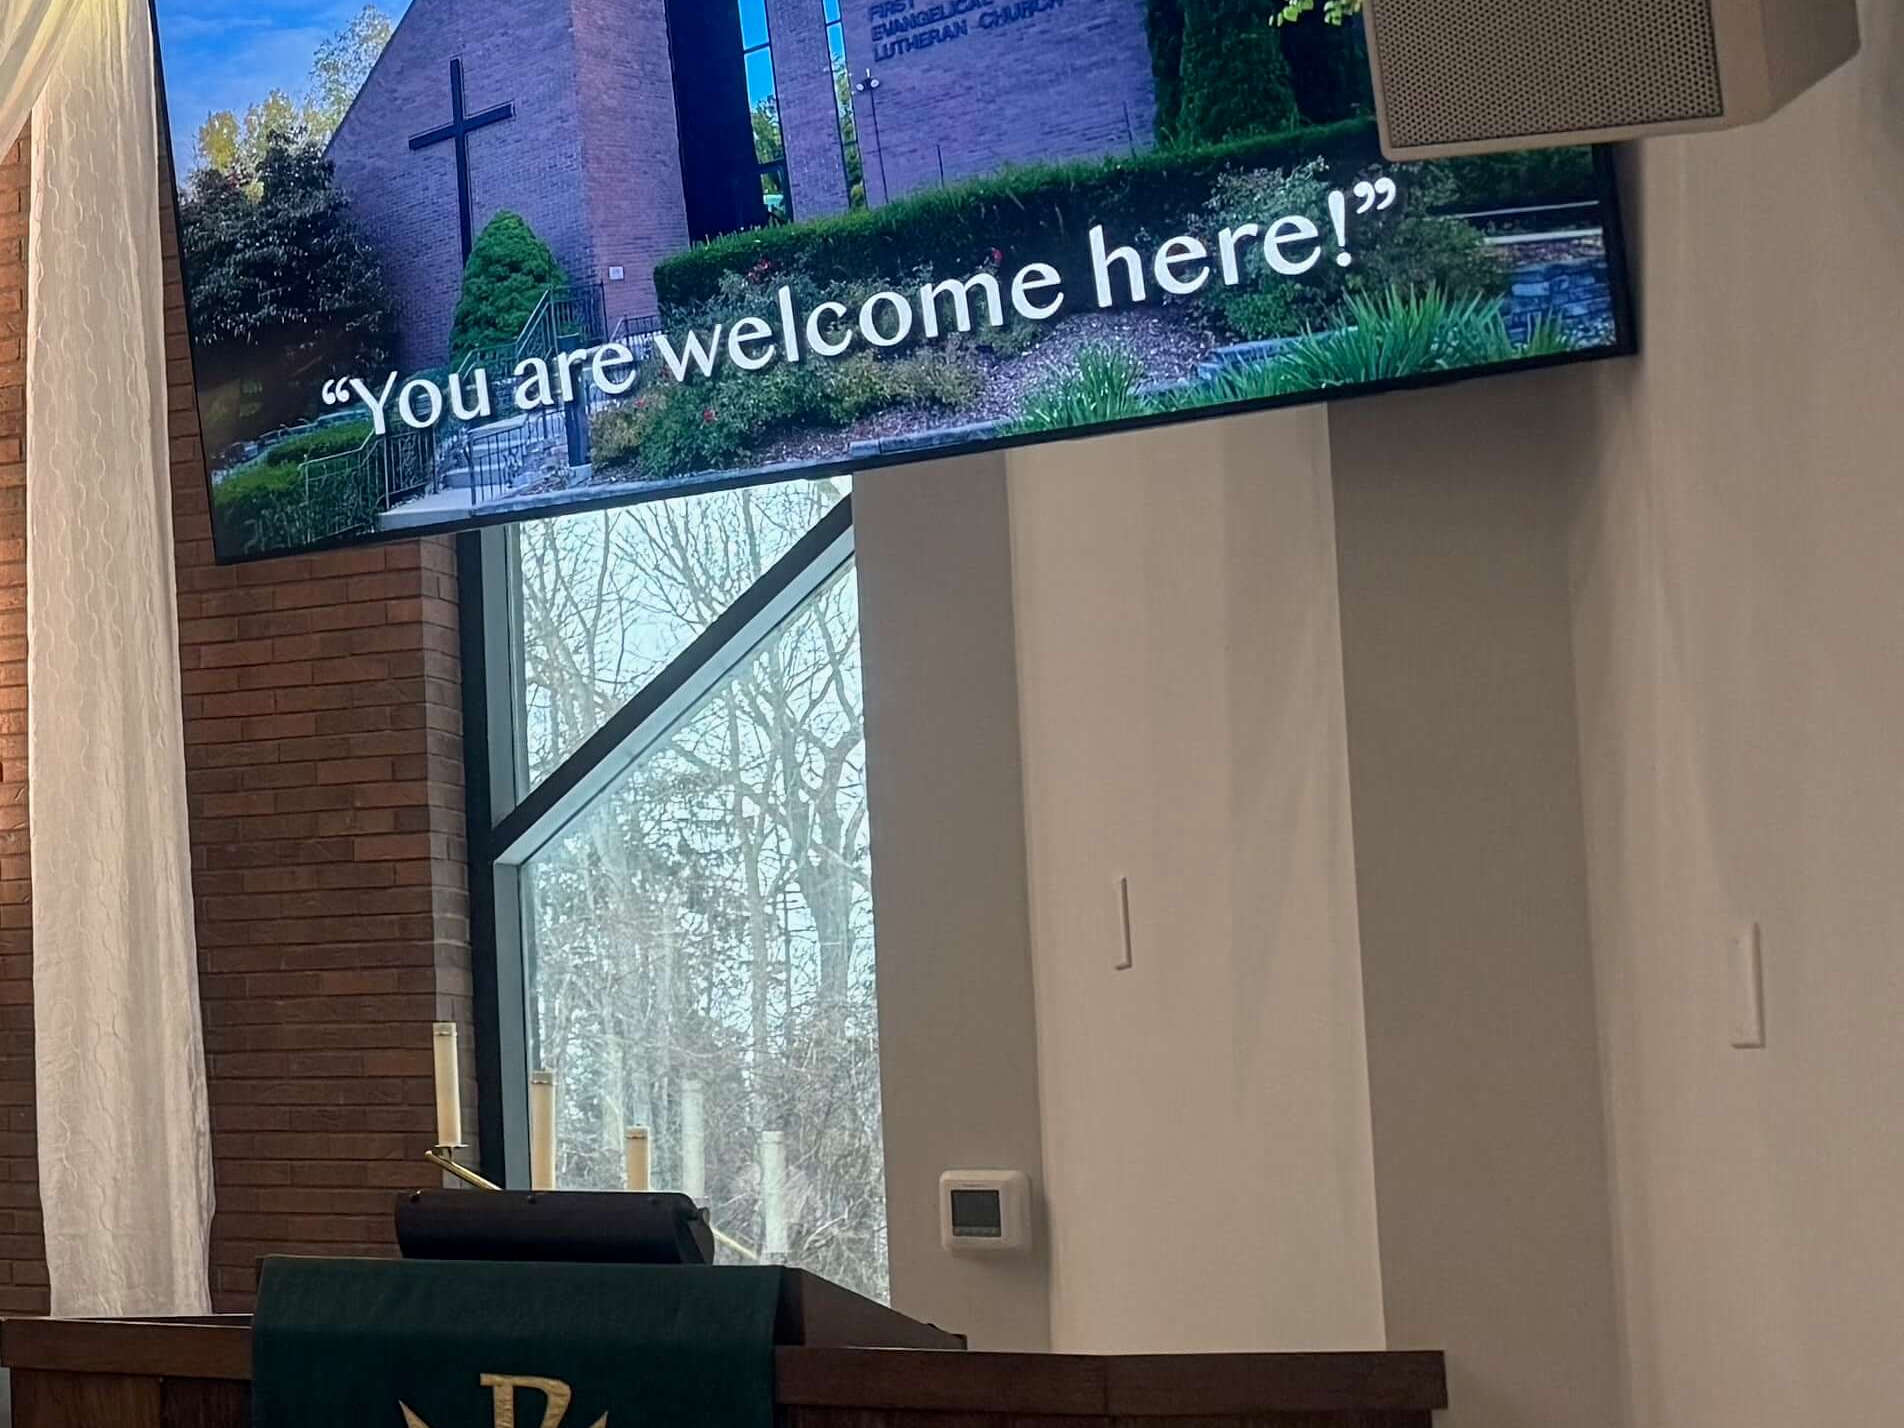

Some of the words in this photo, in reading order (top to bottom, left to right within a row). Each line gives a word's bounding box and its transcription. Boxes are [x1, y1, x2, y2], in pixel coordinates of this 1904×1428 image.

[874, 19, 968, 62] LUTHERAN
[514, 340, 638, 410] are
[653, 261, 1065, 383] welcome
[1088, 176, 1397, 309] here!”
